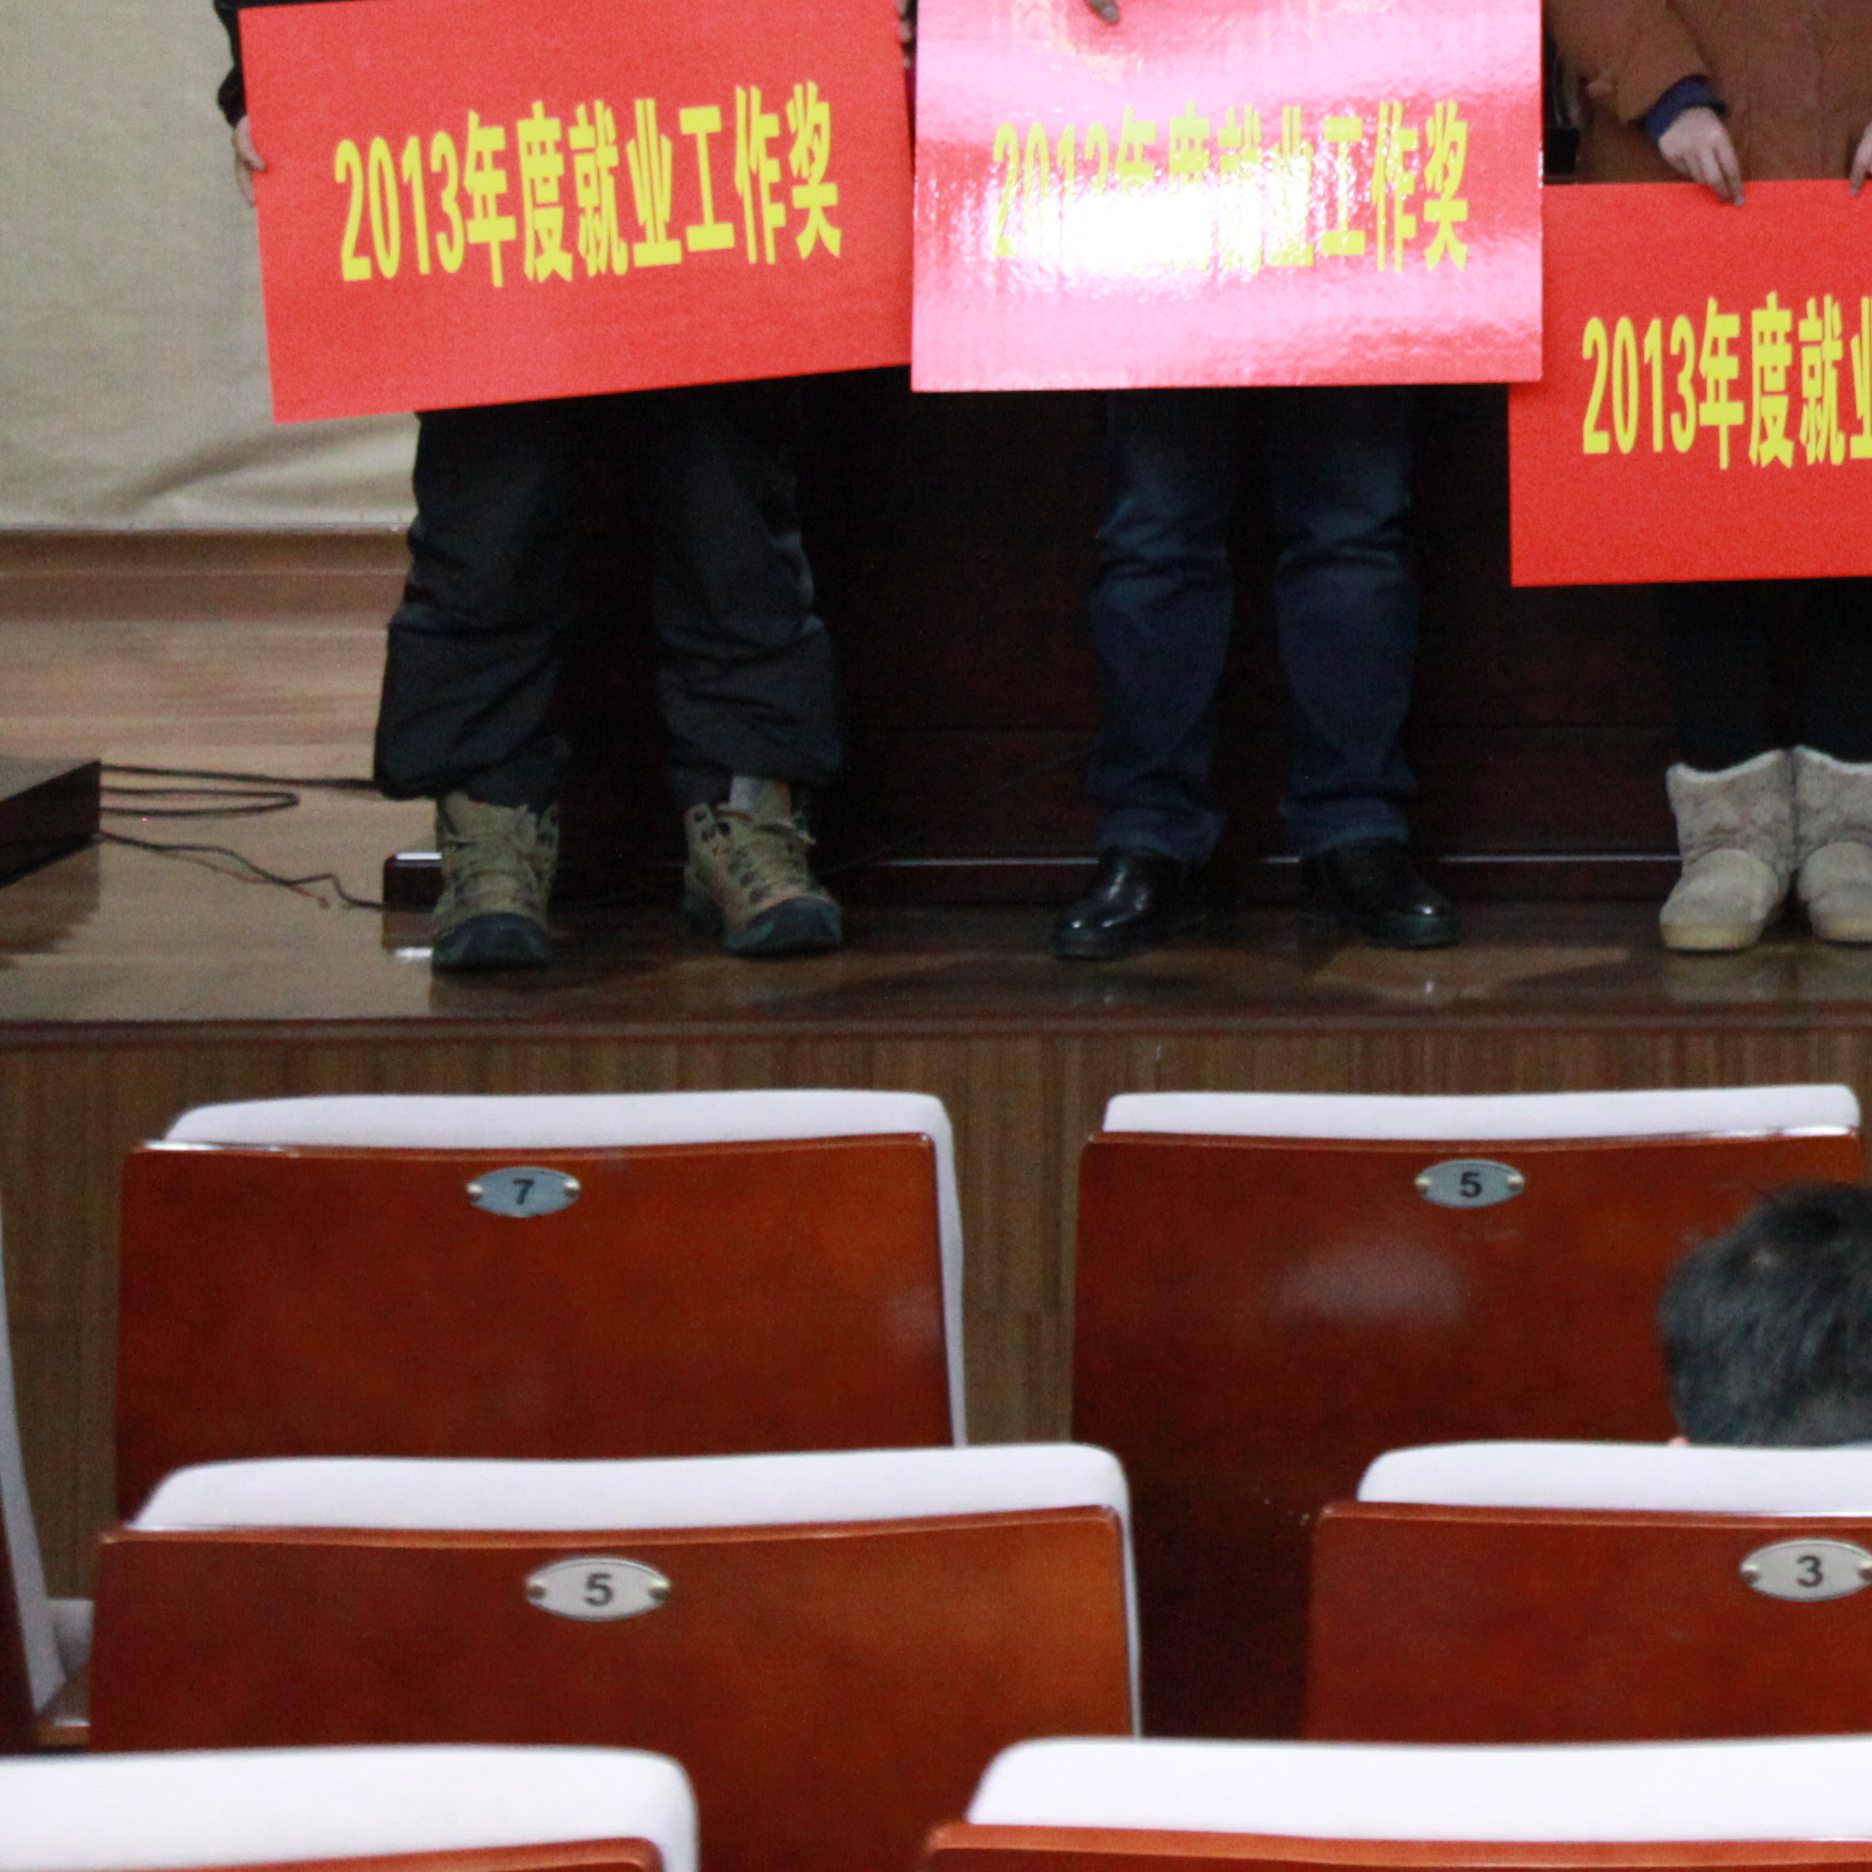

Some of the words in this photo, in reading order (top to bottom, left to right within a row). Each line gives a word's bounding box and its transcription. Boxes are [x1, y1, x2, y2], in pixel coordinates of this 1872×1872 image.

[335, 82, 842, 287] 2013年度就业工作奖
[512, 1178, 535, 1205] 7
[1459, 1170, 1484, 1199] 5
[1796, 1555, 1825, 1588] 3
[585, 1573, 614, 1607] 5
